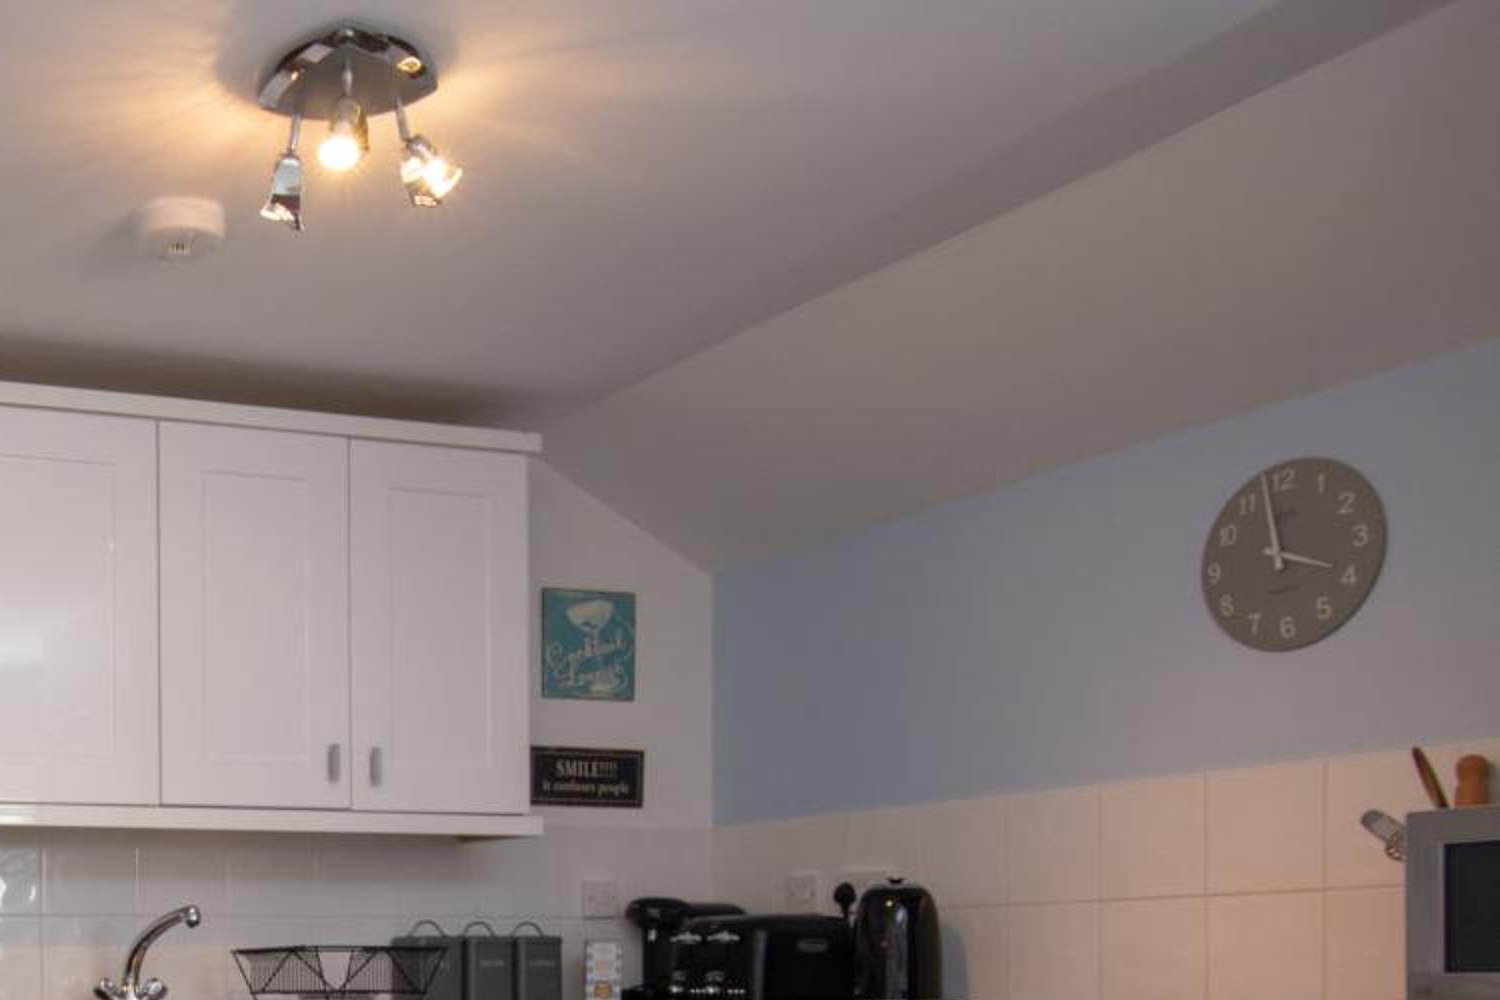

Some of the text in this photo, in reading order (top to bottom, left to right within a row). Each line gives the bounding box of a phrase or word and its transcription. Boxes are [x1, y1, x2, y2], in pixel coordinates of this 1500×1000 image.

[1272, 467, 1296, 491] 12
[1317, 473, 1326, 494] 1
[1238, 493, 1256, 515] 11
[1337, 491, 1355, 513] 2
[1220, 524, 1237, 545] 10
[1352, 524, 1368, 546] 3
[1207, 564, 1221, 584] 9
[1340, 564, 1357, 584] 4
[1219, 594, 1234, 616] 8
[1315, 596, 1332, 619] 5
[1247, 612, 1261, 635] 7
[1280, 616, 1296, 638] 6
